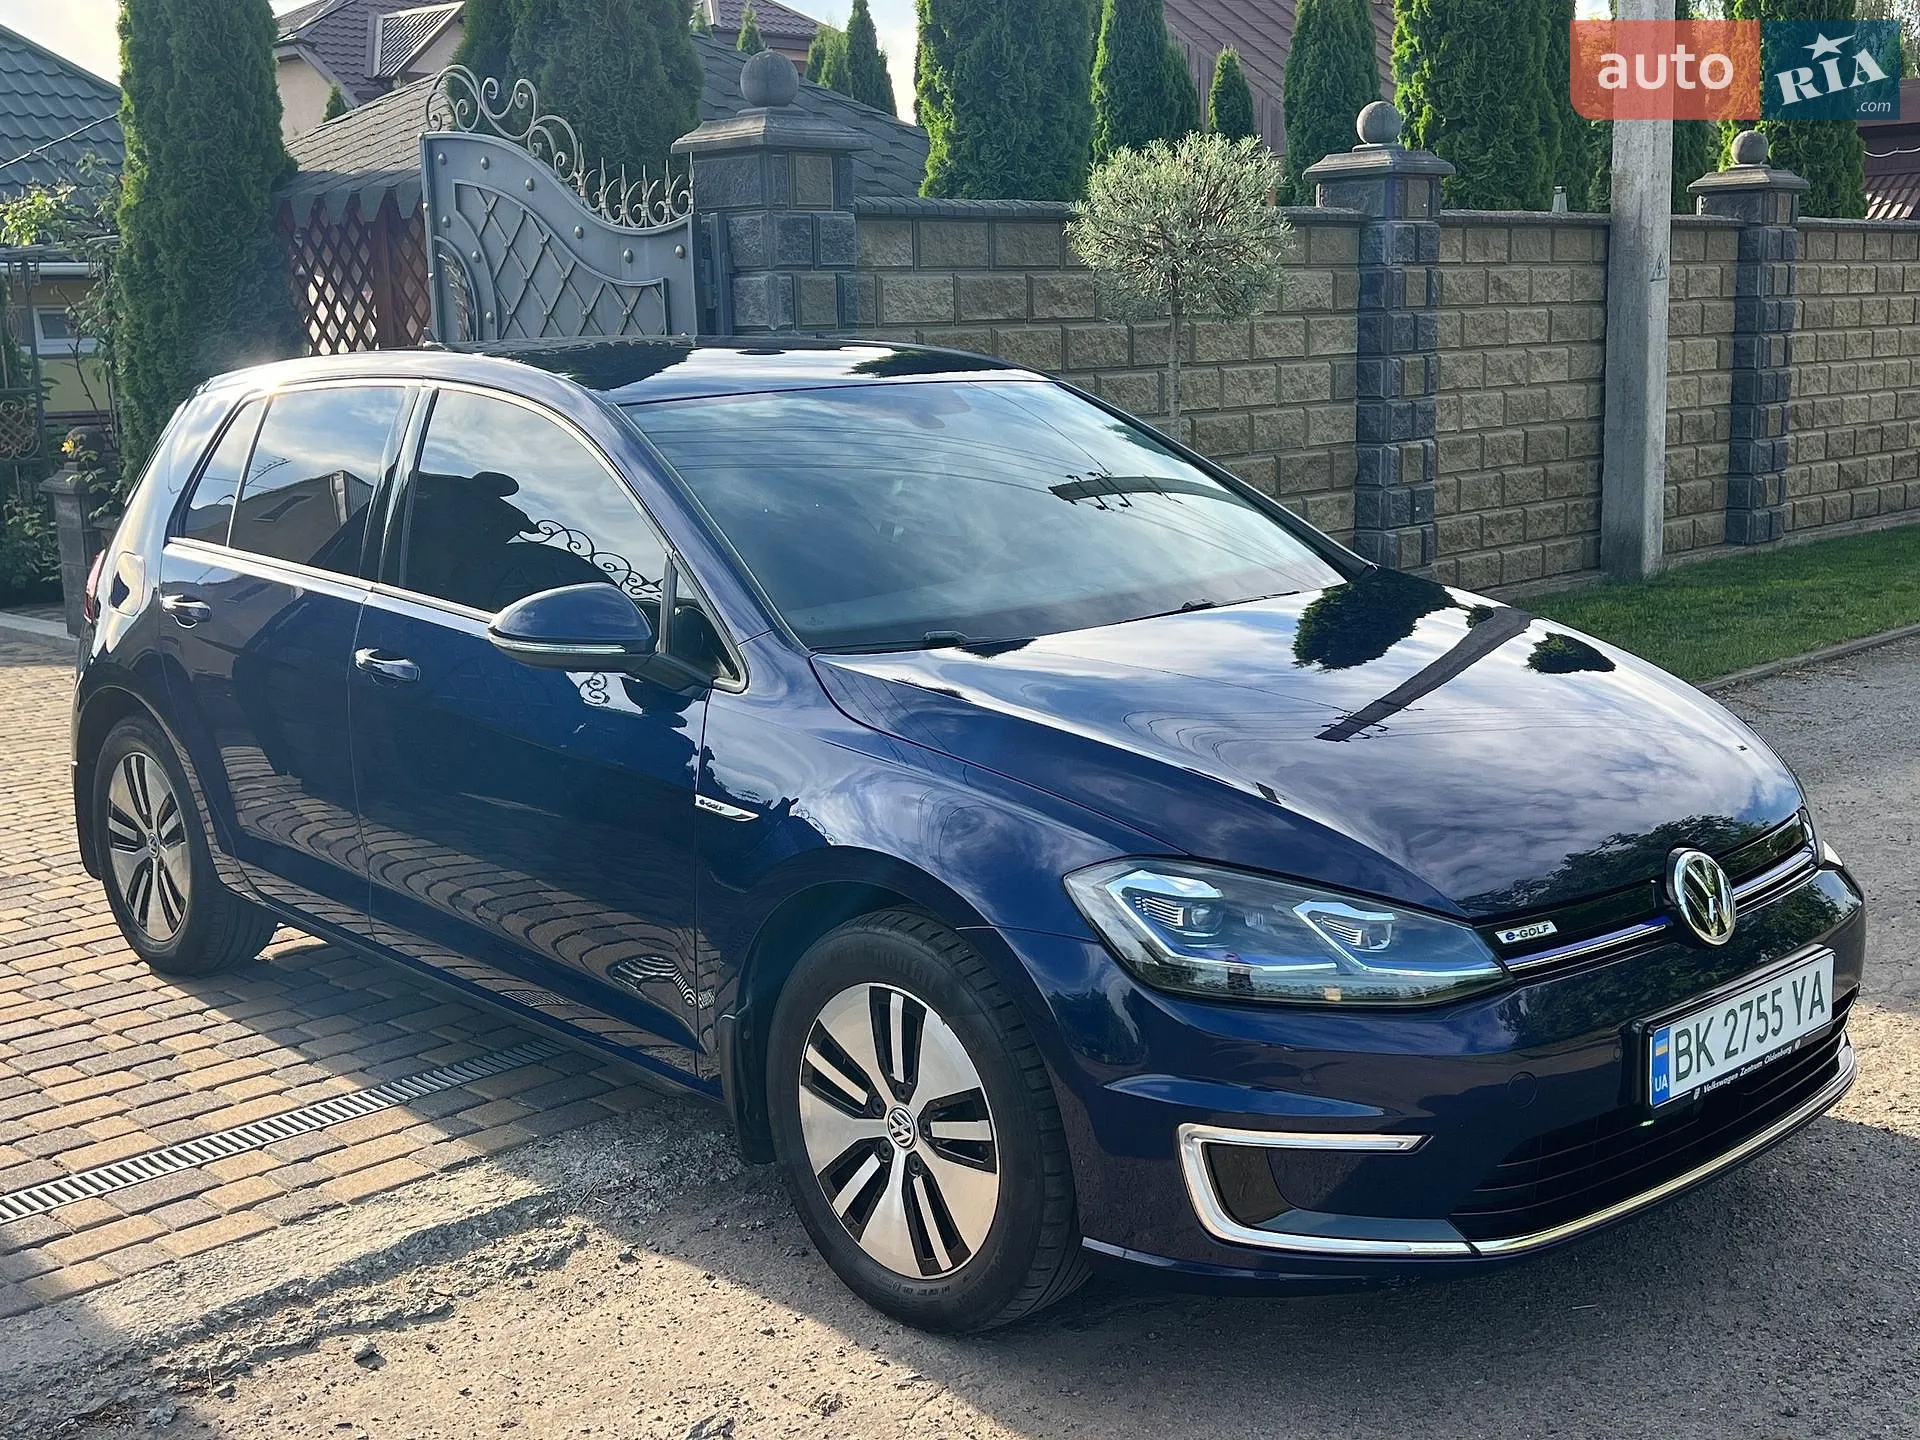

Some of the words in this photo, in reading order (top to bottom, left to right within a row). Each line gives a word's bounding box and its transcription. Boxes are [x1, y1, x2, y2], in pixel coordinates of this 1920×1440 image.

[1505, 924, 1549, 941] e-GOLF
[1675, 1016, 1715, 1082] BK
[1724, 987, 1784, 1060] 2755
[1792, 970, 1826, 1026] YA
[1655, 1076, 1668, 1092] UA
[1703, 1072, 1739, 1094] Volkswagen
[1739, 1060, 1763, 1077] Zentrum
